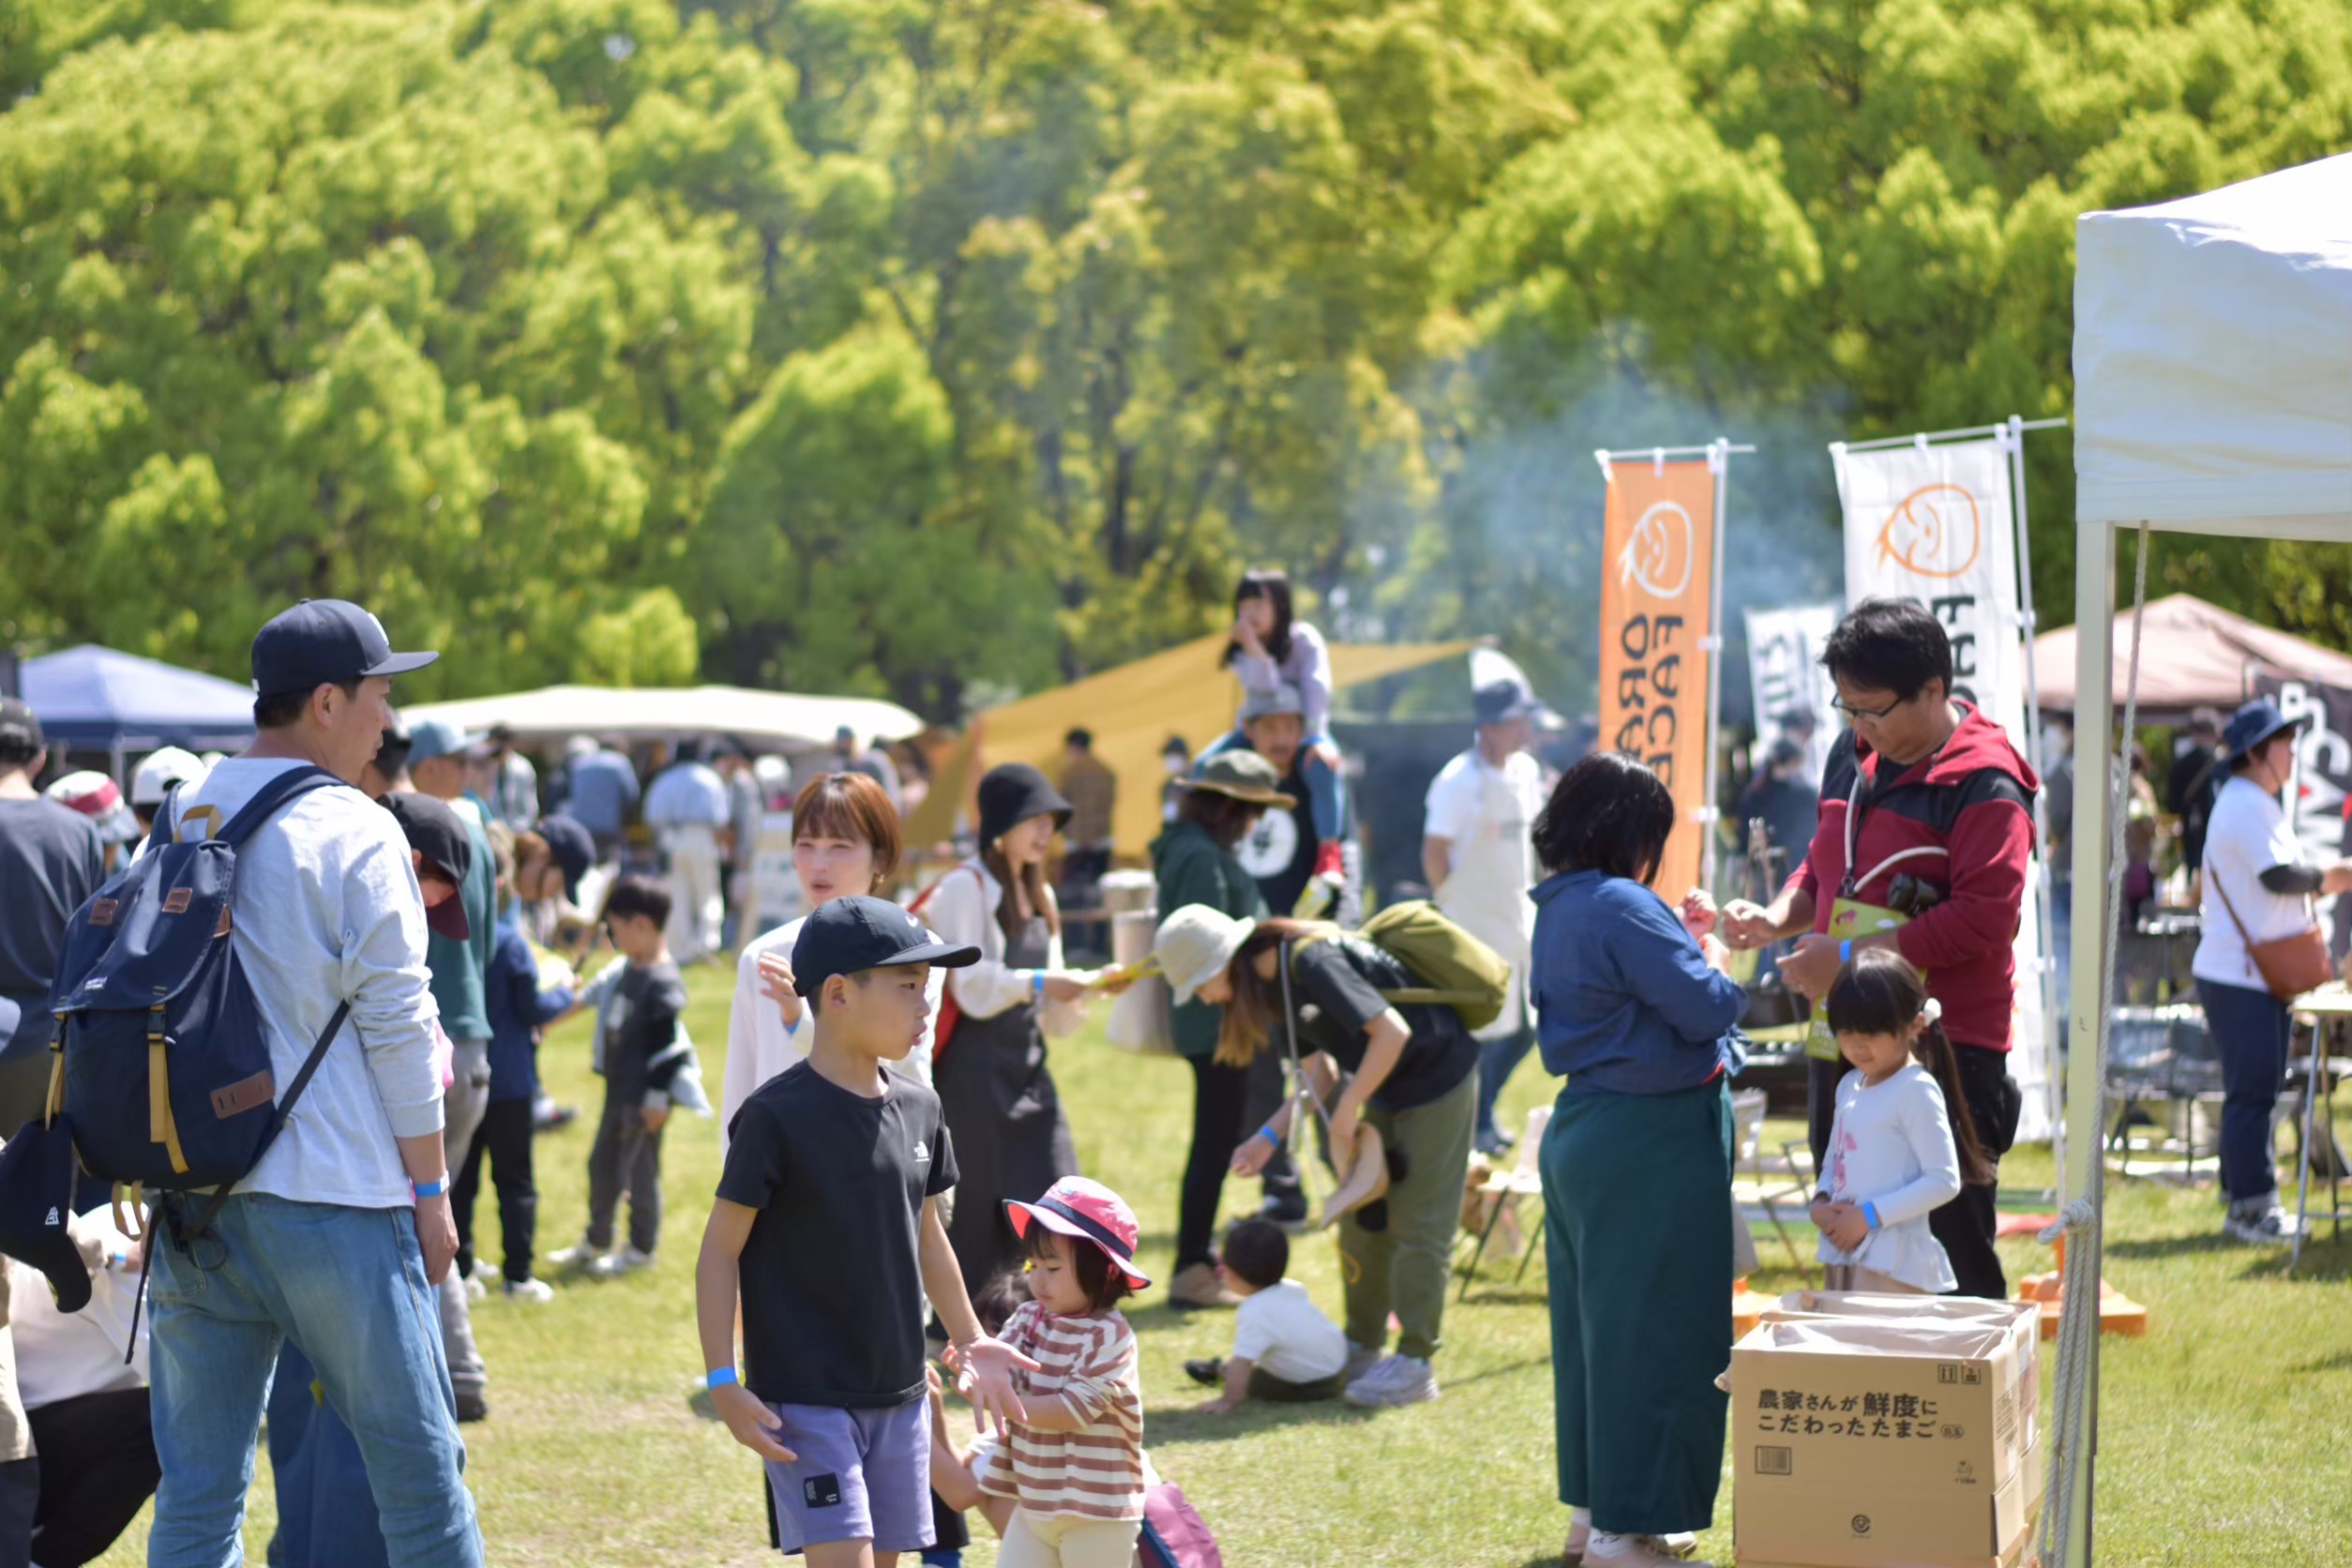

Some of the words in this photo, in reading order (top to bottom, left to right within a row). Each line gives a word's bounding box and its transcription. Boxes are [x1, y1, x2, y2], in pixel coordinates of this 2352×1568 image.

[1757, 1388, 1938, 1419] 農家さんが鮮度に
[1757, 1413, 1937, 1440] こだわったたまご
